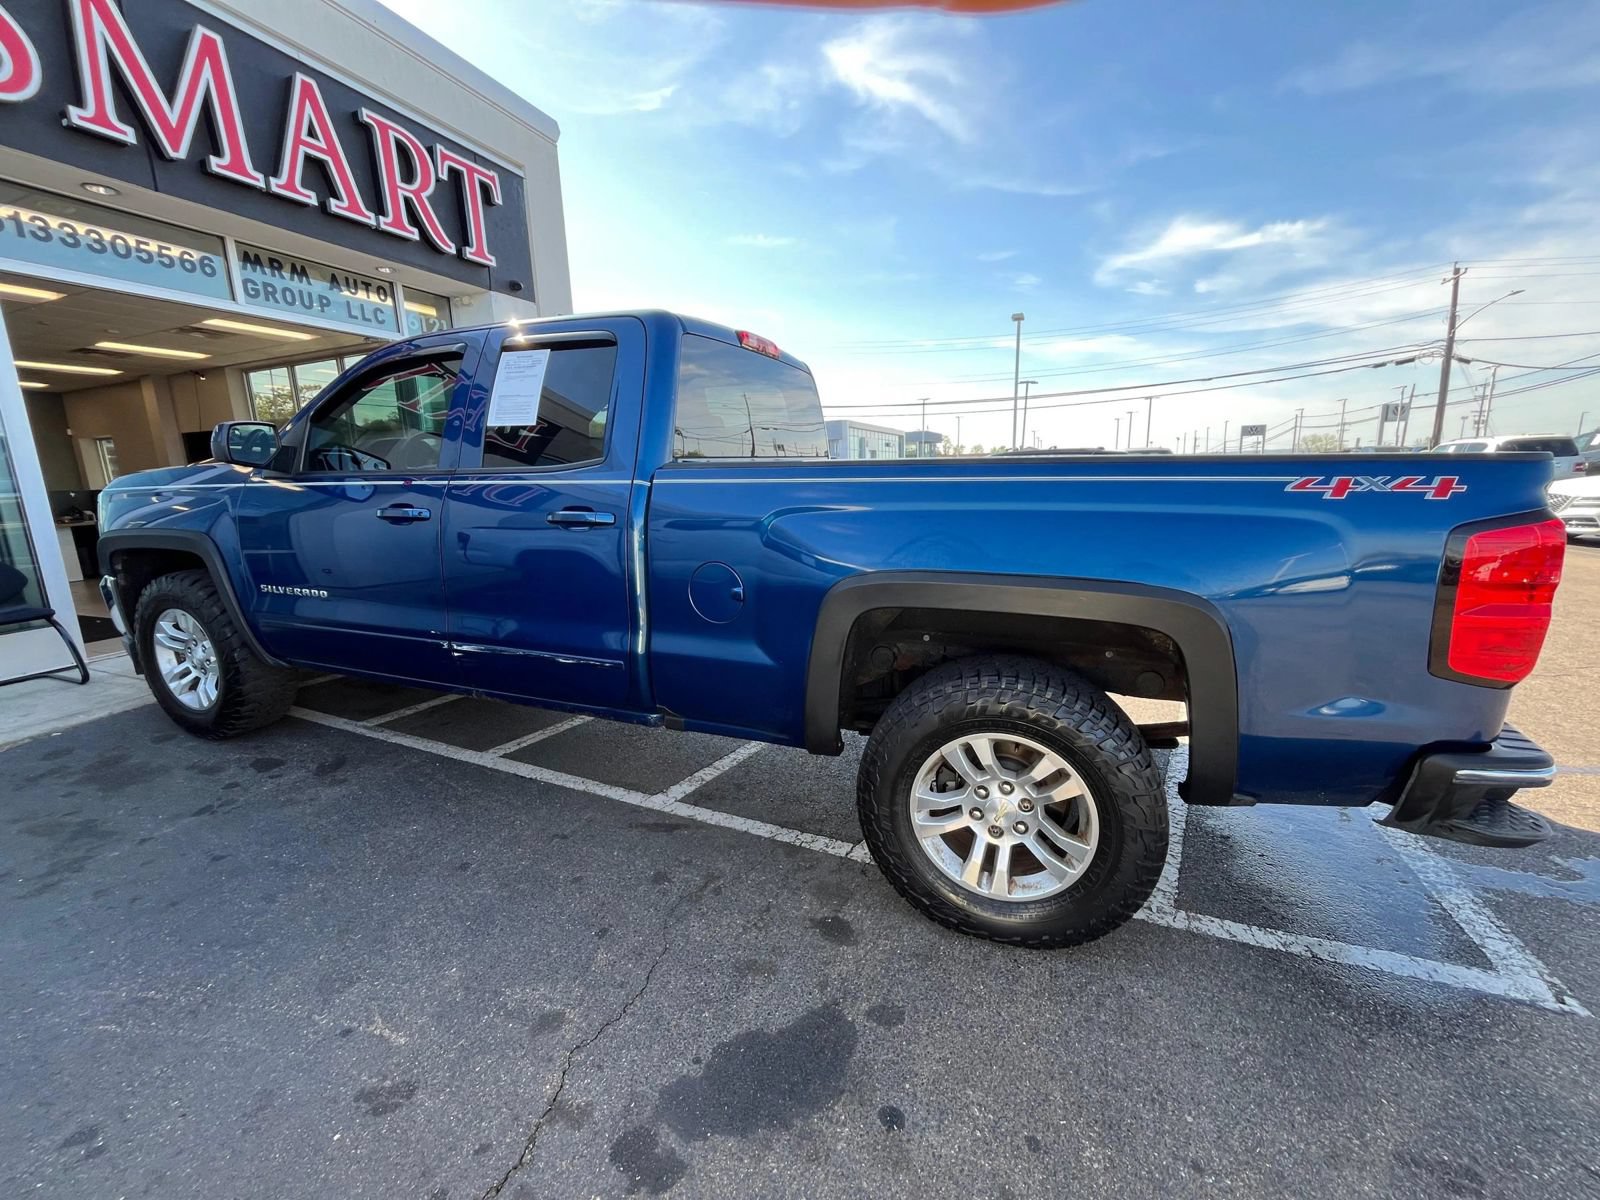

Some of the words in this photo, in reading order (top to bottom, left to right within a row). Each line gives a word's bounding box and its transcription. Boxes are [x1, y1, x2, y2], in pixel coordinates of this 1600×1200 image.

[0, 0, 503, 268] MART
[0, 210, 217, 278] 133305566
[241, 250, 312, 286] MRM
[328, 273, 388, 303] AUTO
[242, 278, 332, 313] GROUP
[346, 300, 386, 325] LLC
[260, 584, 328, 598] SILVERADO
